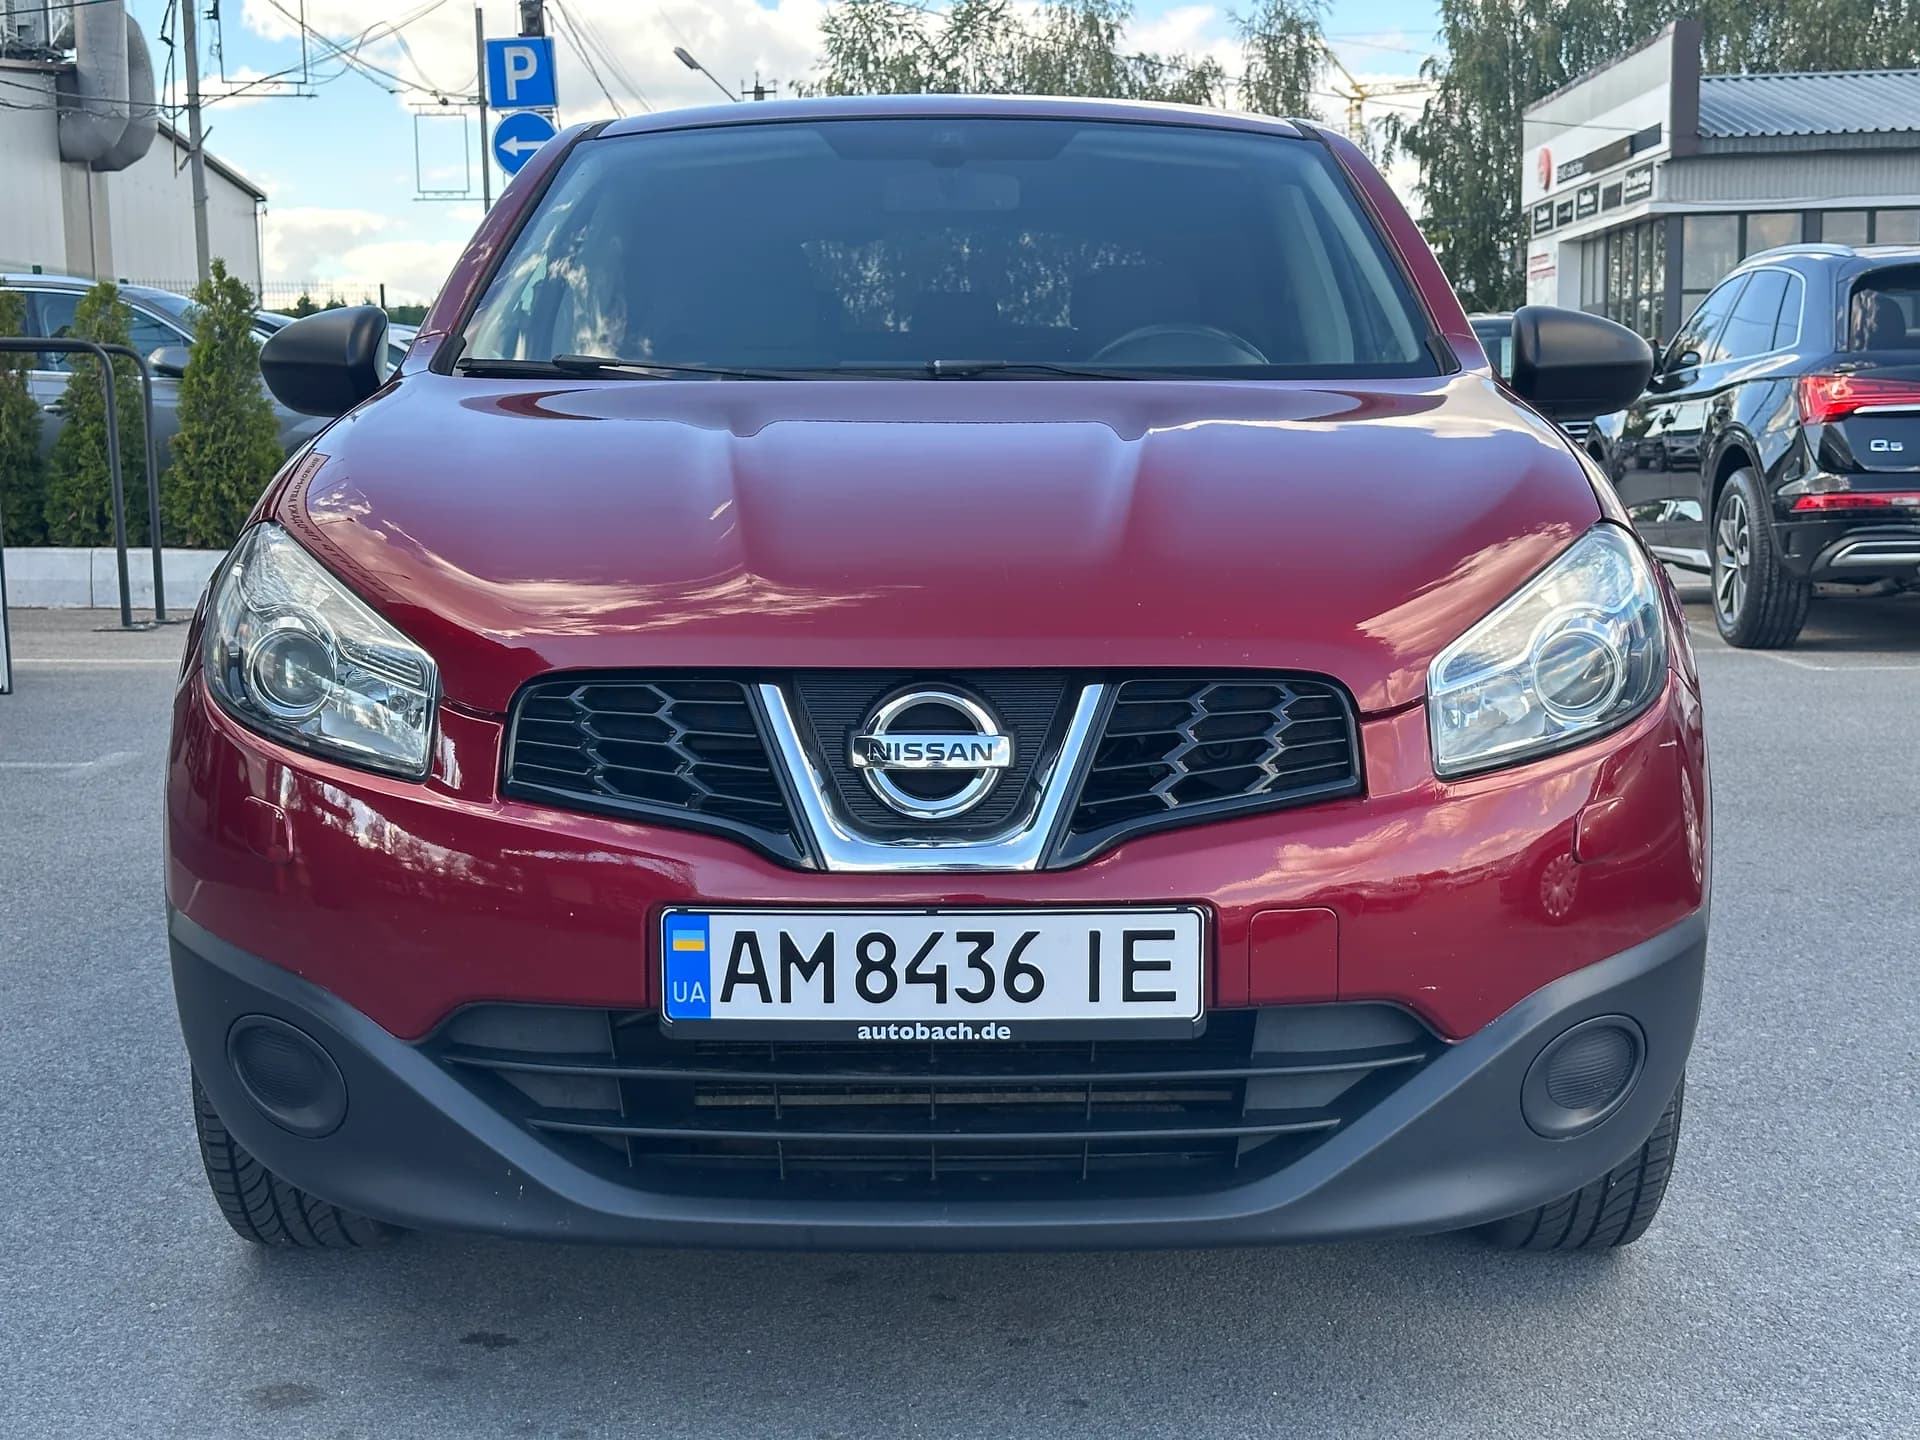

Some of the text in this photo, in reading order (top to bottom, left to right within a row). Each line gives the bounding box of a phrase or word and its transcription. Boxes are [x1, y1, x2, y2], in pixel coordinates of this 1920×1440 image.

[503, 46, 538, 100] P
[1869, 439, 1904, 452] Q5
[868, 743, 993, 761] NISSAN
[719, 929, 1178, 1004] AM 8436 IE
[672, 981, 706, 1004] UA
[857, 1022, 1012, 1041] autobach.de
